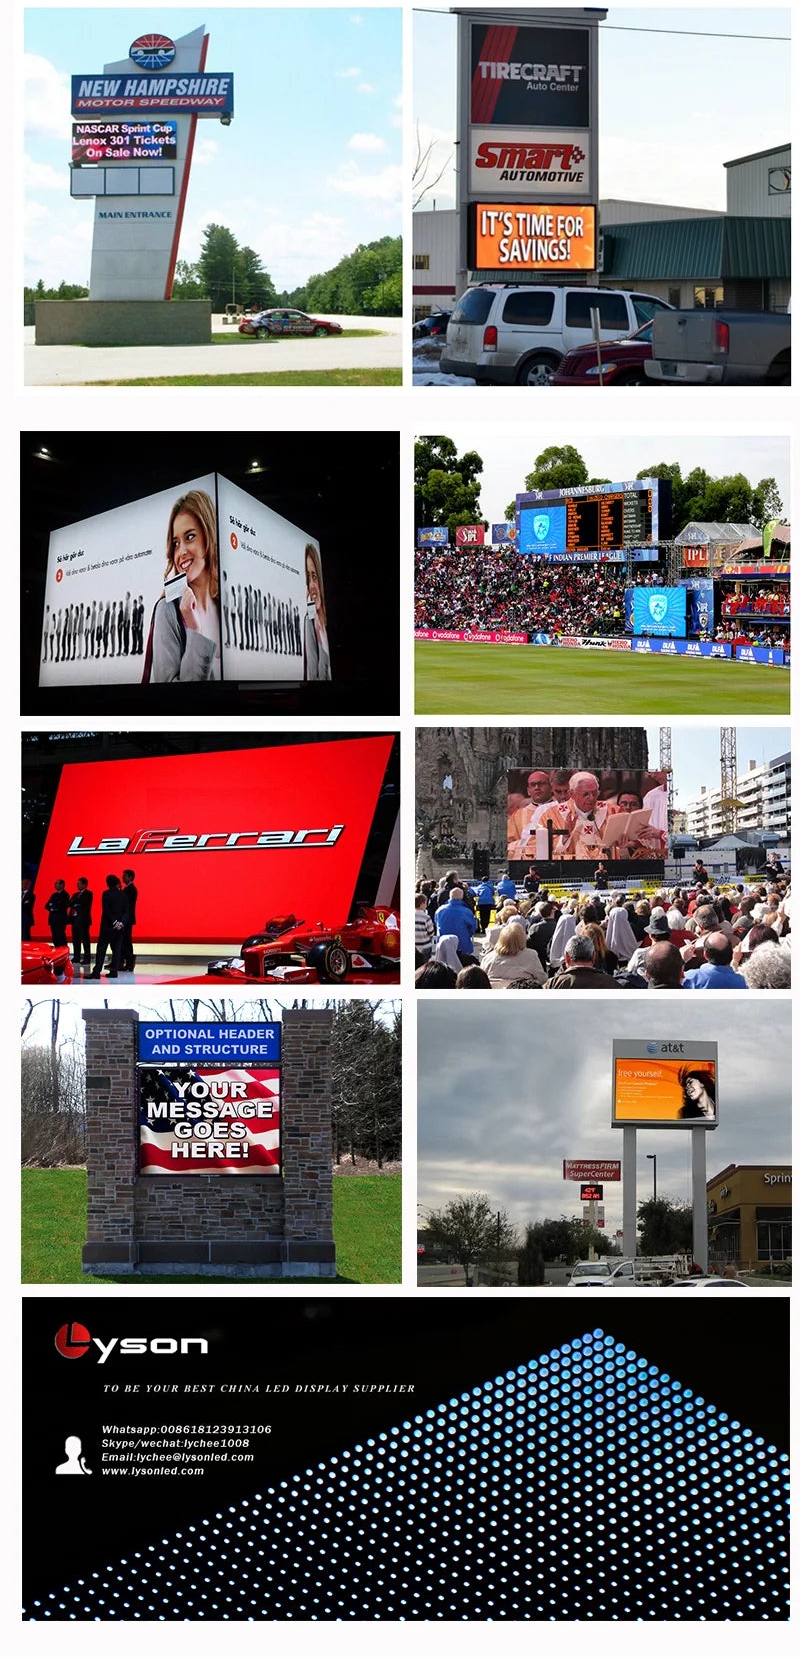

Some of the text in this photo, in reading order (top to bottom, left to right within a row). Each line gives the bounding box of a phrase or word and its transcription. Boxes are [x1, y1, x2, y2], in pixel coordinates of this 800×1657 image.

[478, 61, 583, 83] TIRECRAFT
[78, 78, 230, 97] NEW HAMPSHIRE
[526, 82, 579, 92] Auto Center
[77, 97, 224, 107] MOTOR SPEEDWAY
[76, 124, 173, 135] NASCAR Sprint Cup
[72, 135, 176, 146] Lenox 301 Tickets
[86, 147, 163, 158] On Sale Now!
[475, 142, 574, 171] Smart
[499, 170, 584, 183] AUTOMOTIVE
[481, 210, 584, 237] IT'S TIME FOR
[499, 238, 571, 263] SAVINGS!
[560, 485, 605, 497] JOHANNESBURG
[553, 554, 573, 562] INDIAN
[574, 553, 598, 561] PREMIER
[437, 630, 460, 639] vodafone
[67, 824, 345, 855] LaFerrari
[145, 1029, 275, 1039] OPTIONAL HEADER
[151, 1044, 268, 1054] AND STRUCTURE
[661, 1043, 685, 1053] at&t
[617, 1069, 633, 1078] free
[173, 1081, 248, 1099] YOUR
[147, 1101, 273, 1119] MESSAGE
[174, 1121, 247, 1139] GOES
[171, 1141, 249, 1159] HERE!
[570, 1170, 614, 1178] SuperCenter
